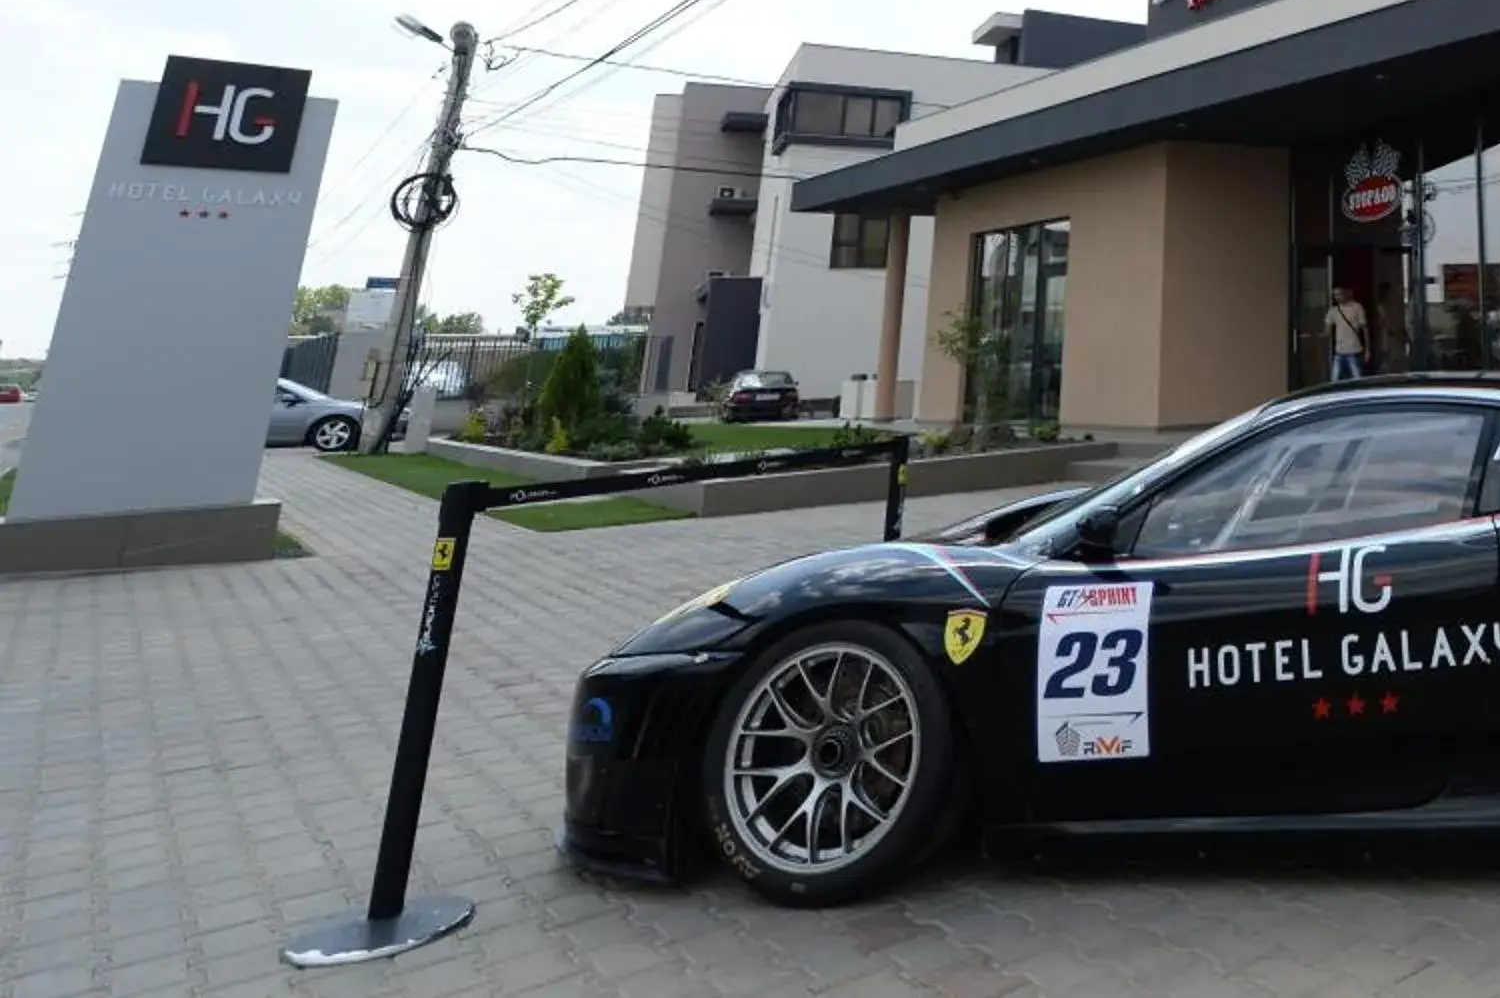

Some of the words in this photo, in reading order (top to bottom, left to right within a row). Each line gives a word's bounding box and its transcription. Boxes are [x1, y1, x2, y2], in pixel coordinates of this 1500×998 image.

[176, 80, 277, 145] HG
[106, 181, 188, 202] HOTEL
[1089, 586, 1138, 608] SPRINT
[1305, 544, 1393, 616] HG
[1043, 628, 1144, 700] 23
[1187, 637, 1323, 688] HOTEL
